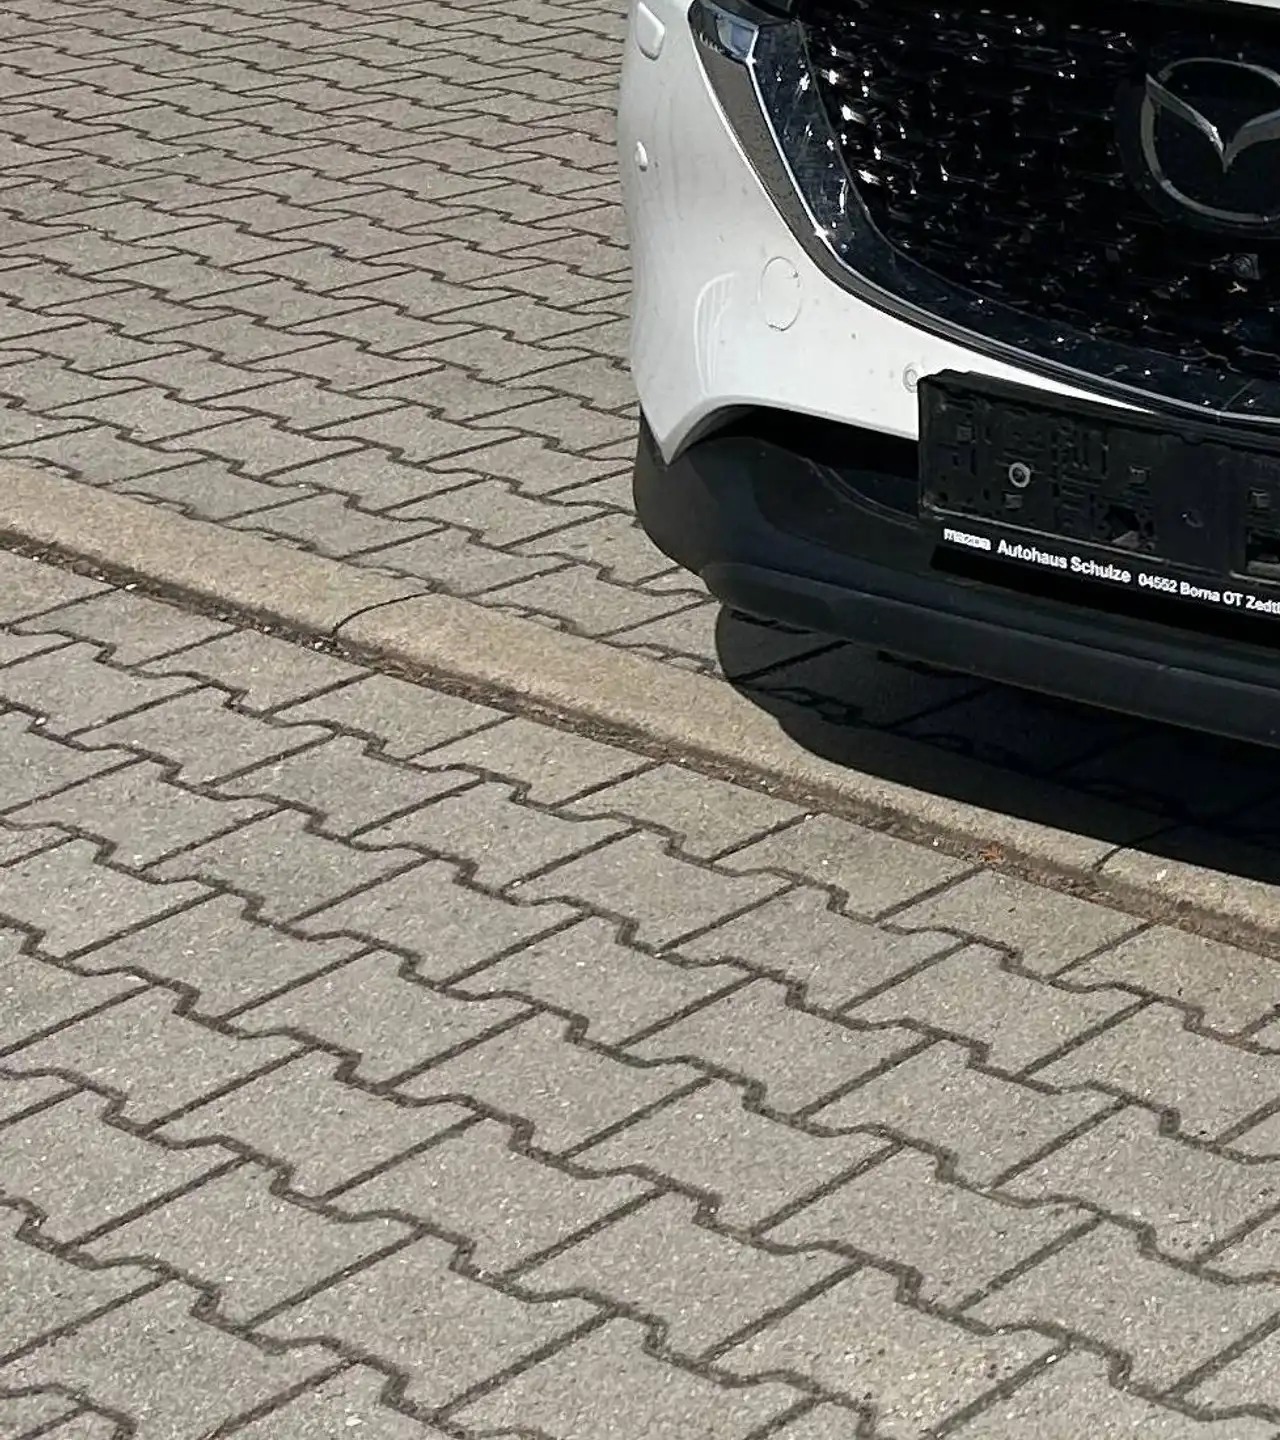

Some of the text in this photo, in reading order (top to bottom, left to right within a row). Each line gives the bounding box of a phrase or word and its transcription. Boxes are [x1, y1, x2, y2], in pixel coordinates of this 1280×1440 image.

[997, 539, 1067, 569] Autohaus
[1070, 555, 1132, 583] Schulze
[1138, 573, 1177, 593] 04552
[1180, 581, 1221, 602] Borna
[1223, 591, 1243, 607] OT
